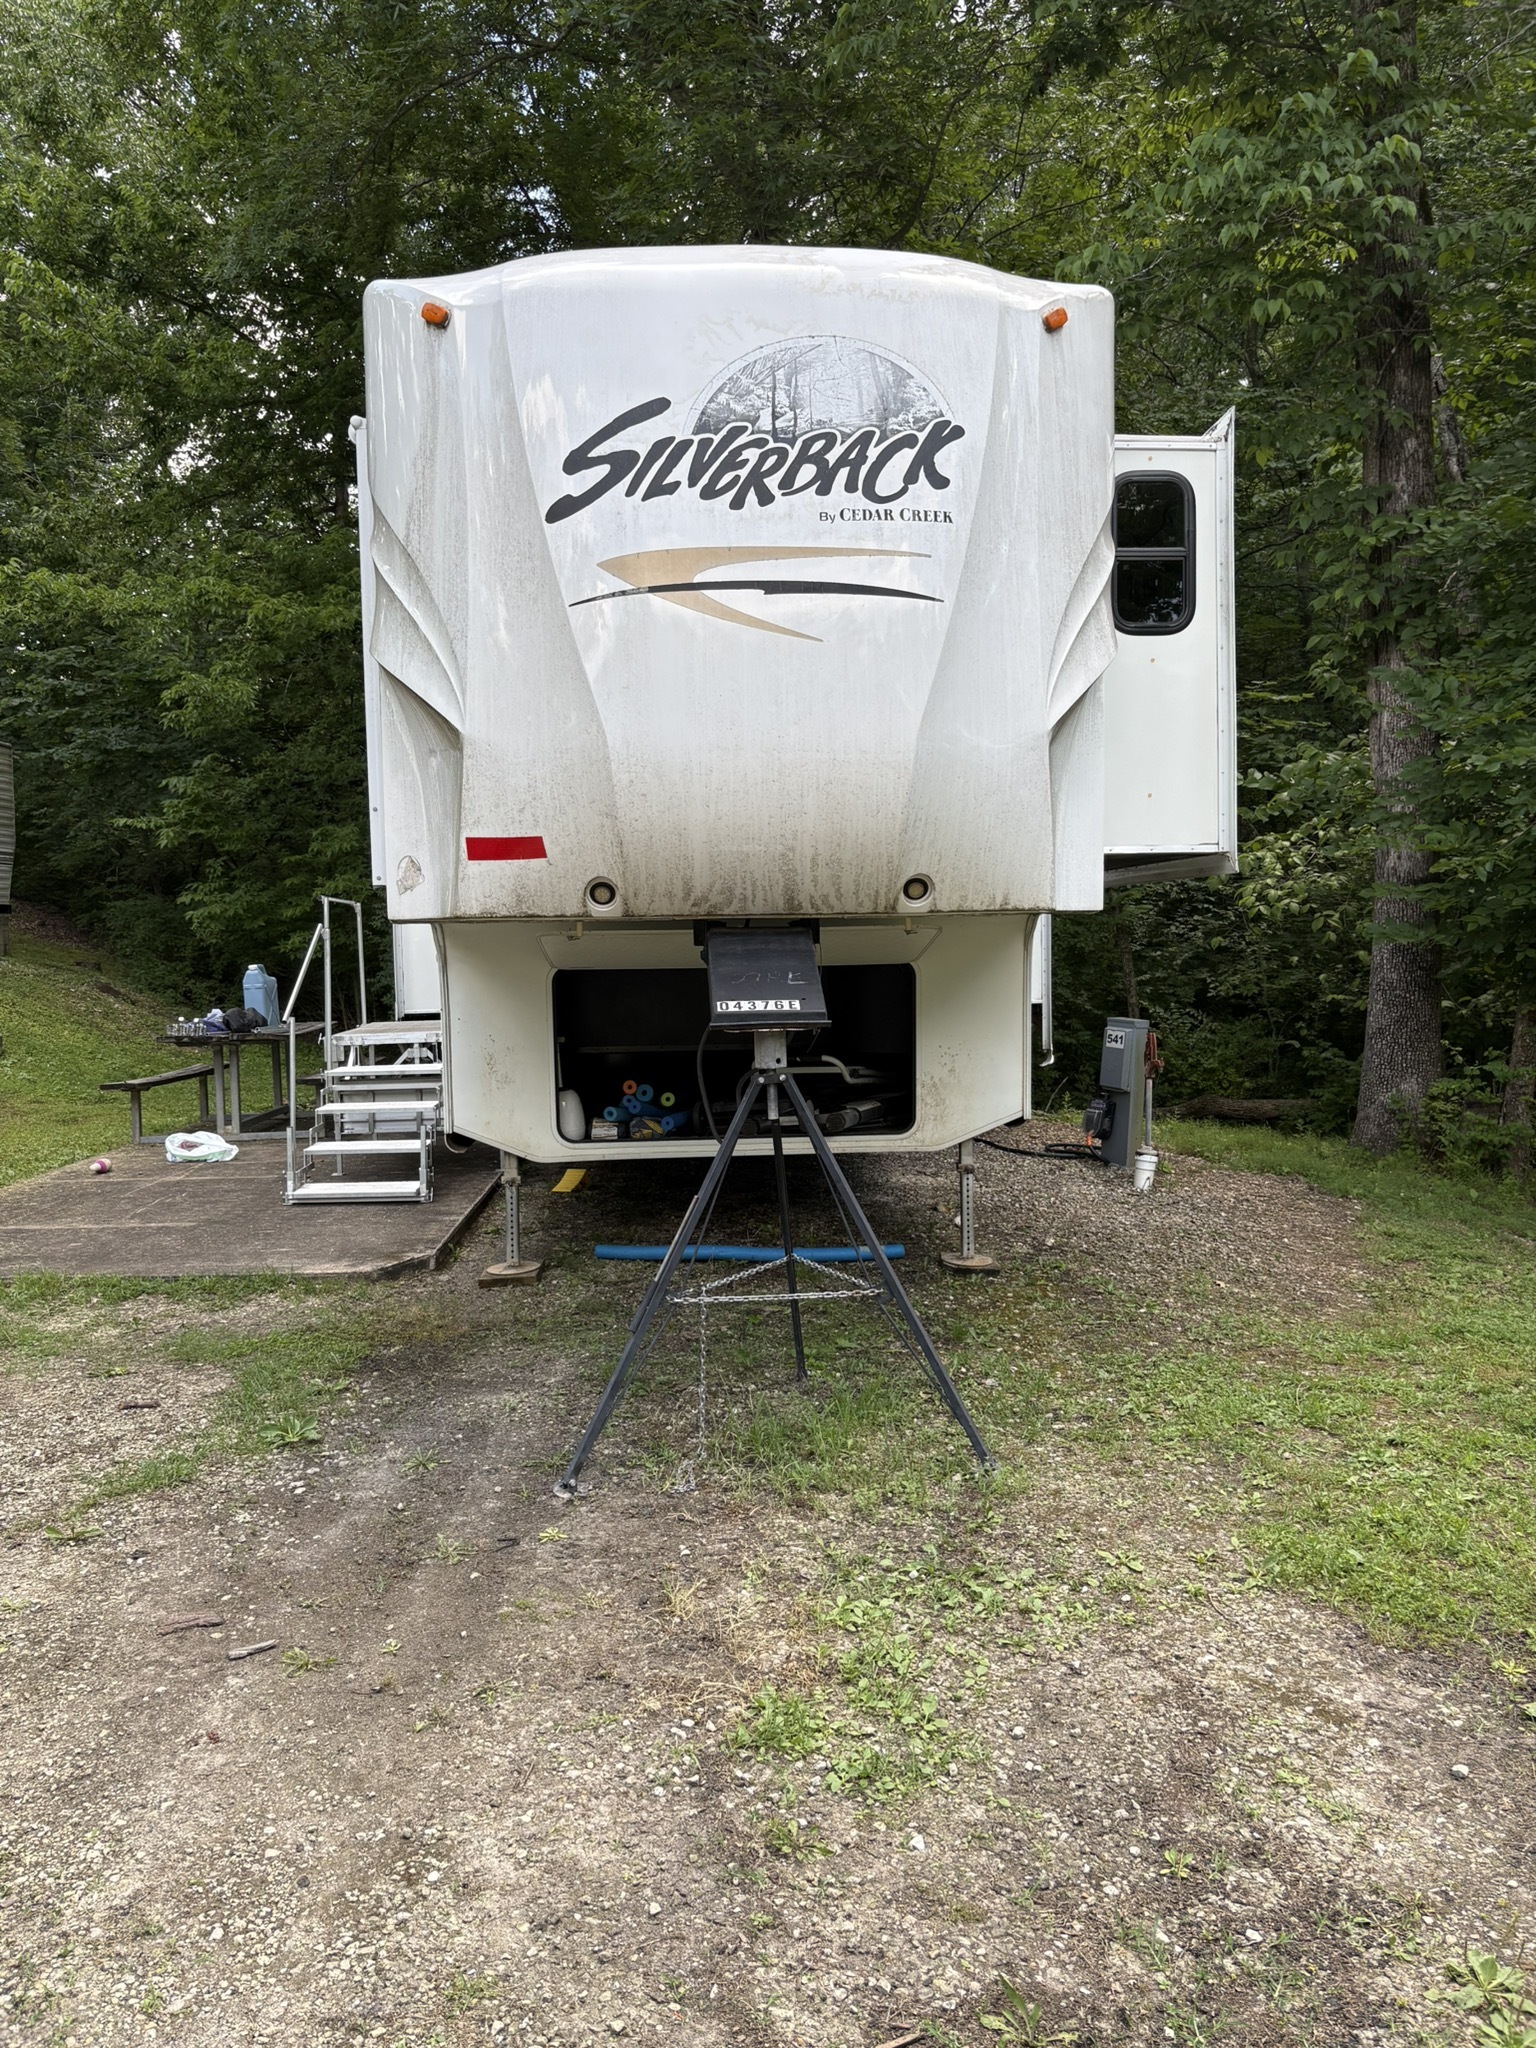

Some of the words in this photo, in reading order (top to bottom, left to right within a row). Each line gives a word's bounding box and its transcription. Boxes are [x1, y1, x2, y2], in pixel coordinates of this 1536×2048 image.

[545, 397, 966, 524] SILVERBACK
[819, 511, 836, 524] By
[839, 507, 895, 522] CEDAR
[899, 507, 954, 524] CREEK
[719, 1000, 798, 1011] 04376E
[1107, 1034, 1124, 1045] 541
